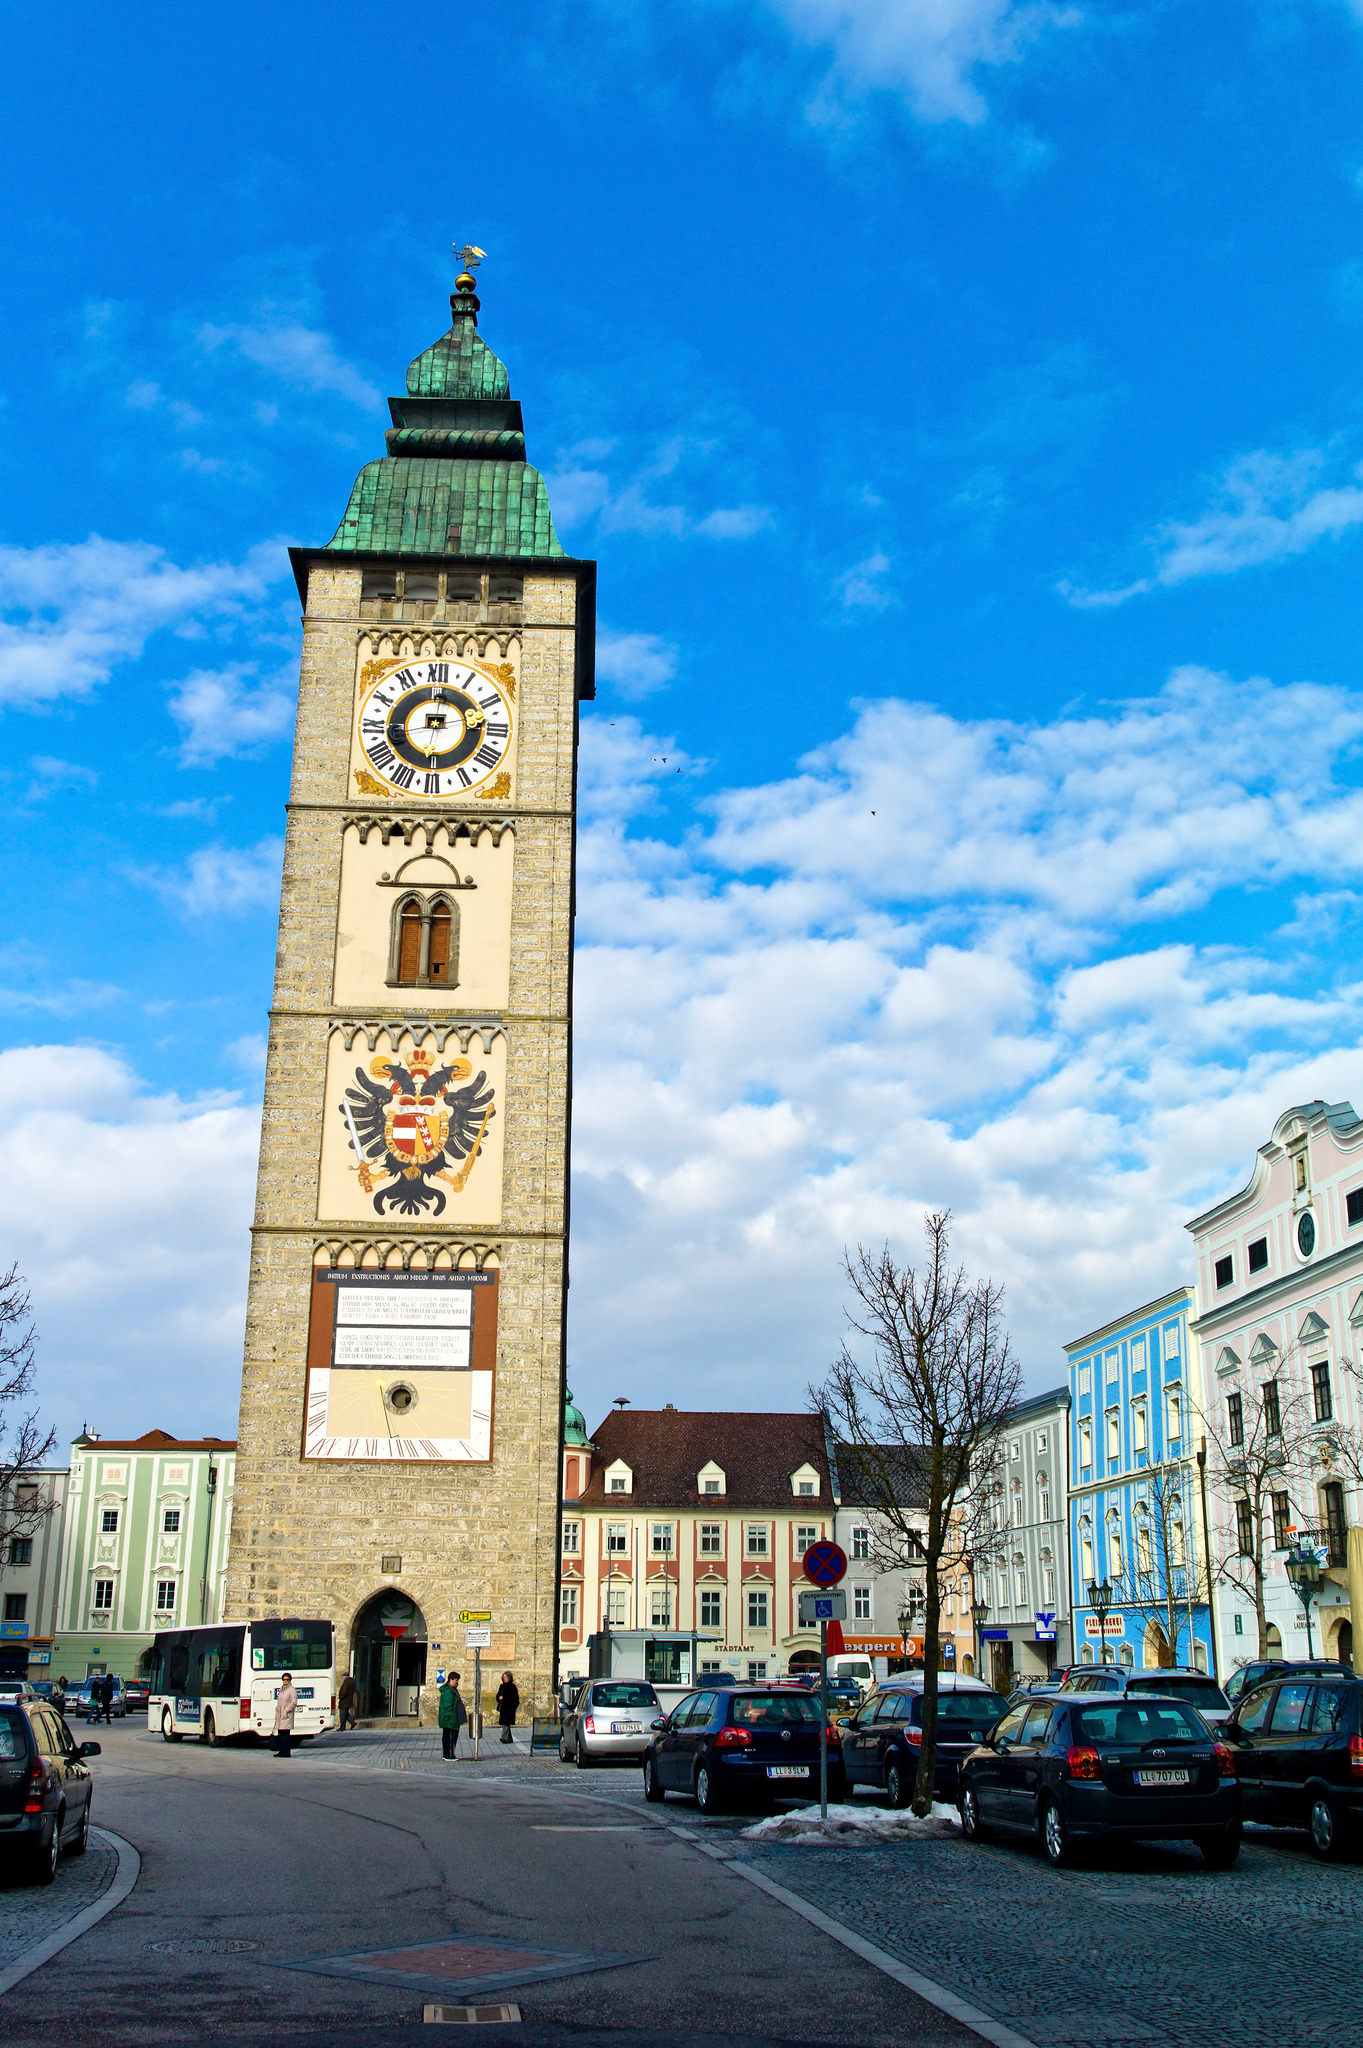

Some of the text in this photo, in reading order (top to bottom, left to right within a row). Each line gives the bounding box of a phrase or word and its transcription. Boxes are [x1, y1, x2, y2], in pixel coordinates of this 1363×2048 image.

[804, 1591, 843, 1599] ausgenommen
[1086, 1617, 1122, 1627] FLEISHEREI
[284, 1629, 299, 1639] 404
[844, 1642, 895, 1653] expert
[1156, 1770, 1172, 1780] 707
